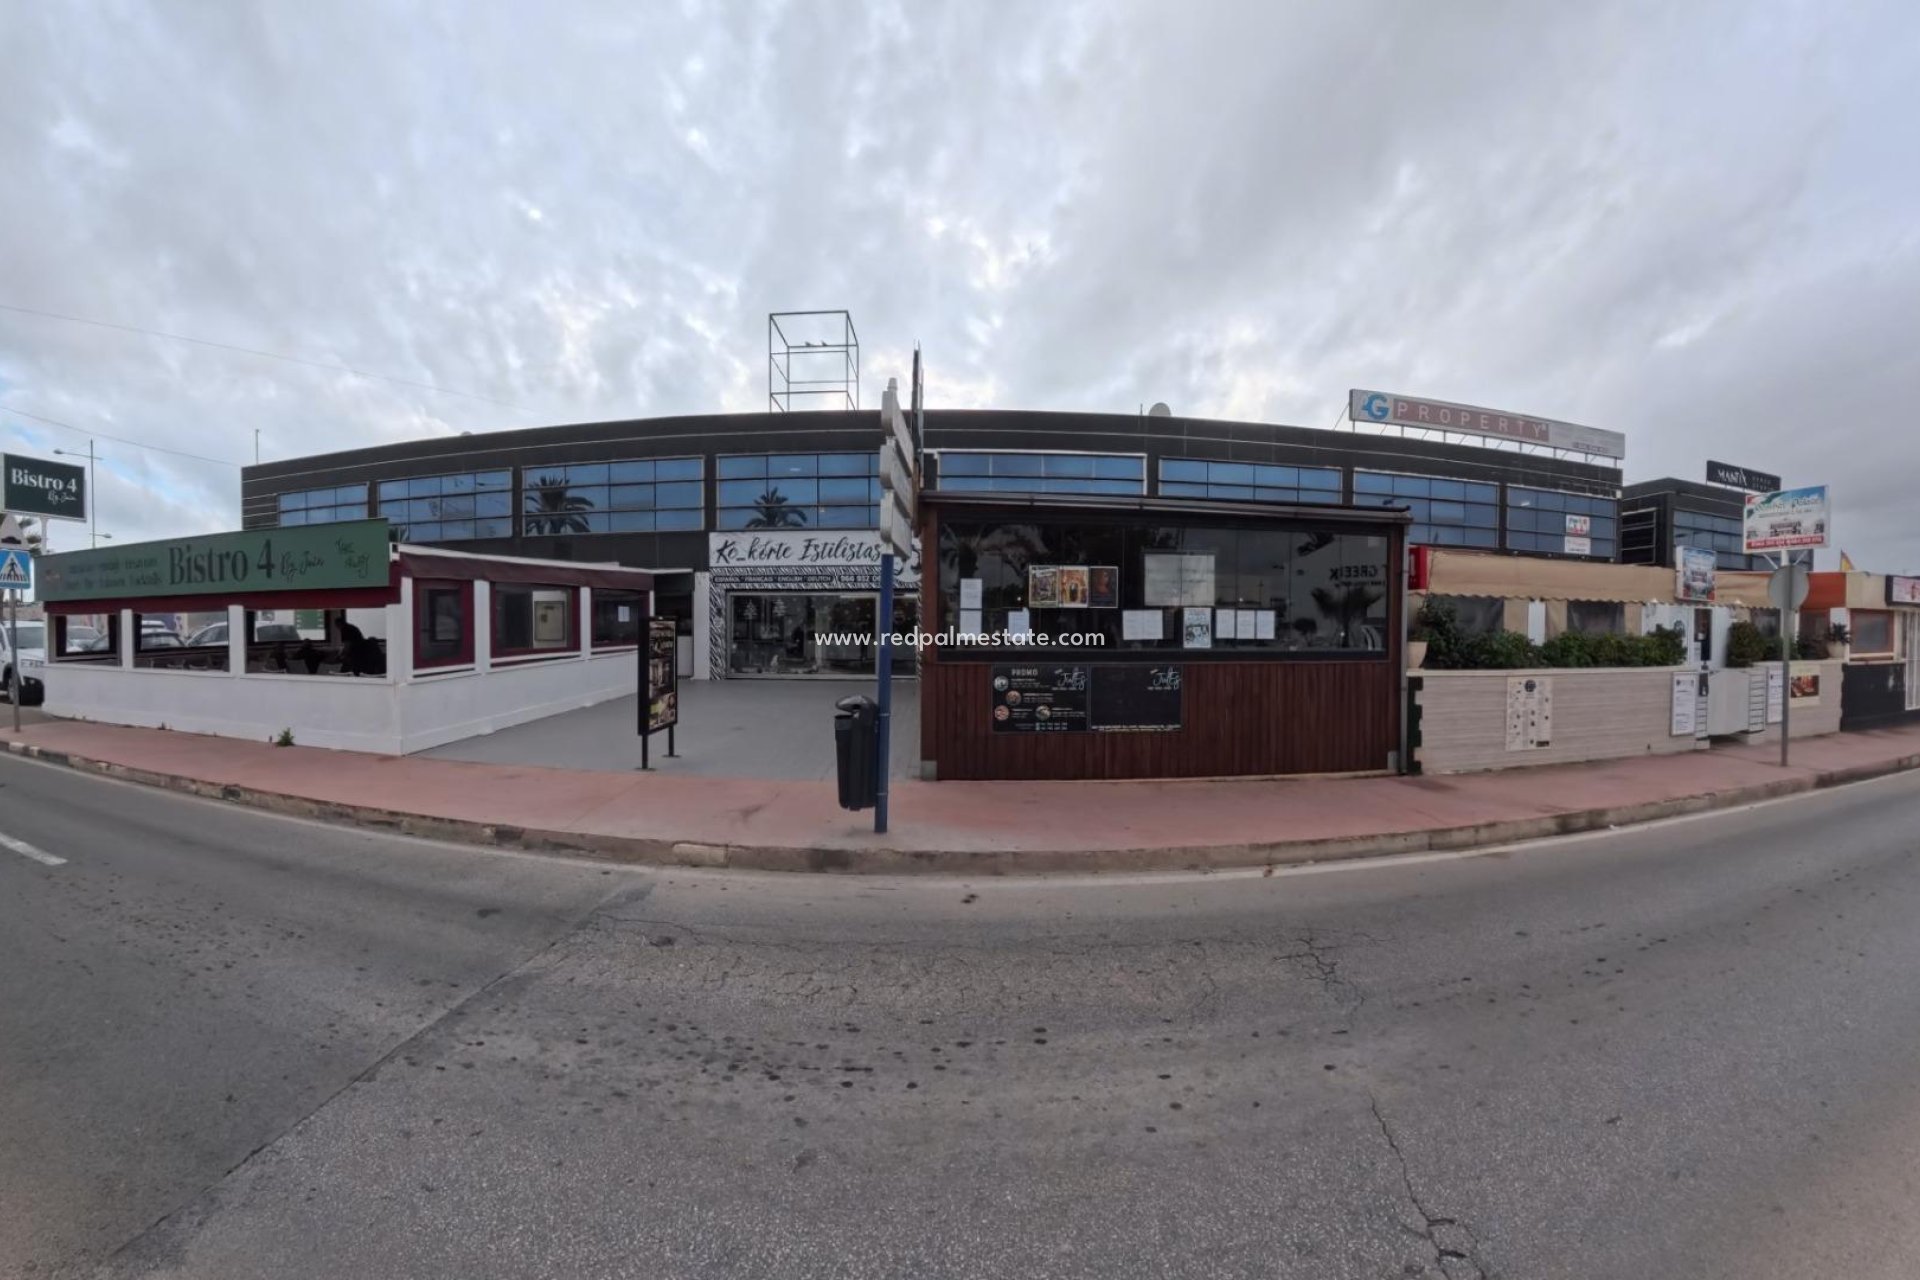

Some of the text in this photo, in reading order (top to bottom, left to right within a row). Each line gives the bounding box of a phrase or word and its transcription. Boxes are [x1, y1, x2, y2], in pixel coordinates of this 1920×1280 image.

[12, 467, 77, 493] Bistro 4
[168, 543, 248, 585] Bistro
[257, 538, 275, 579] 4
